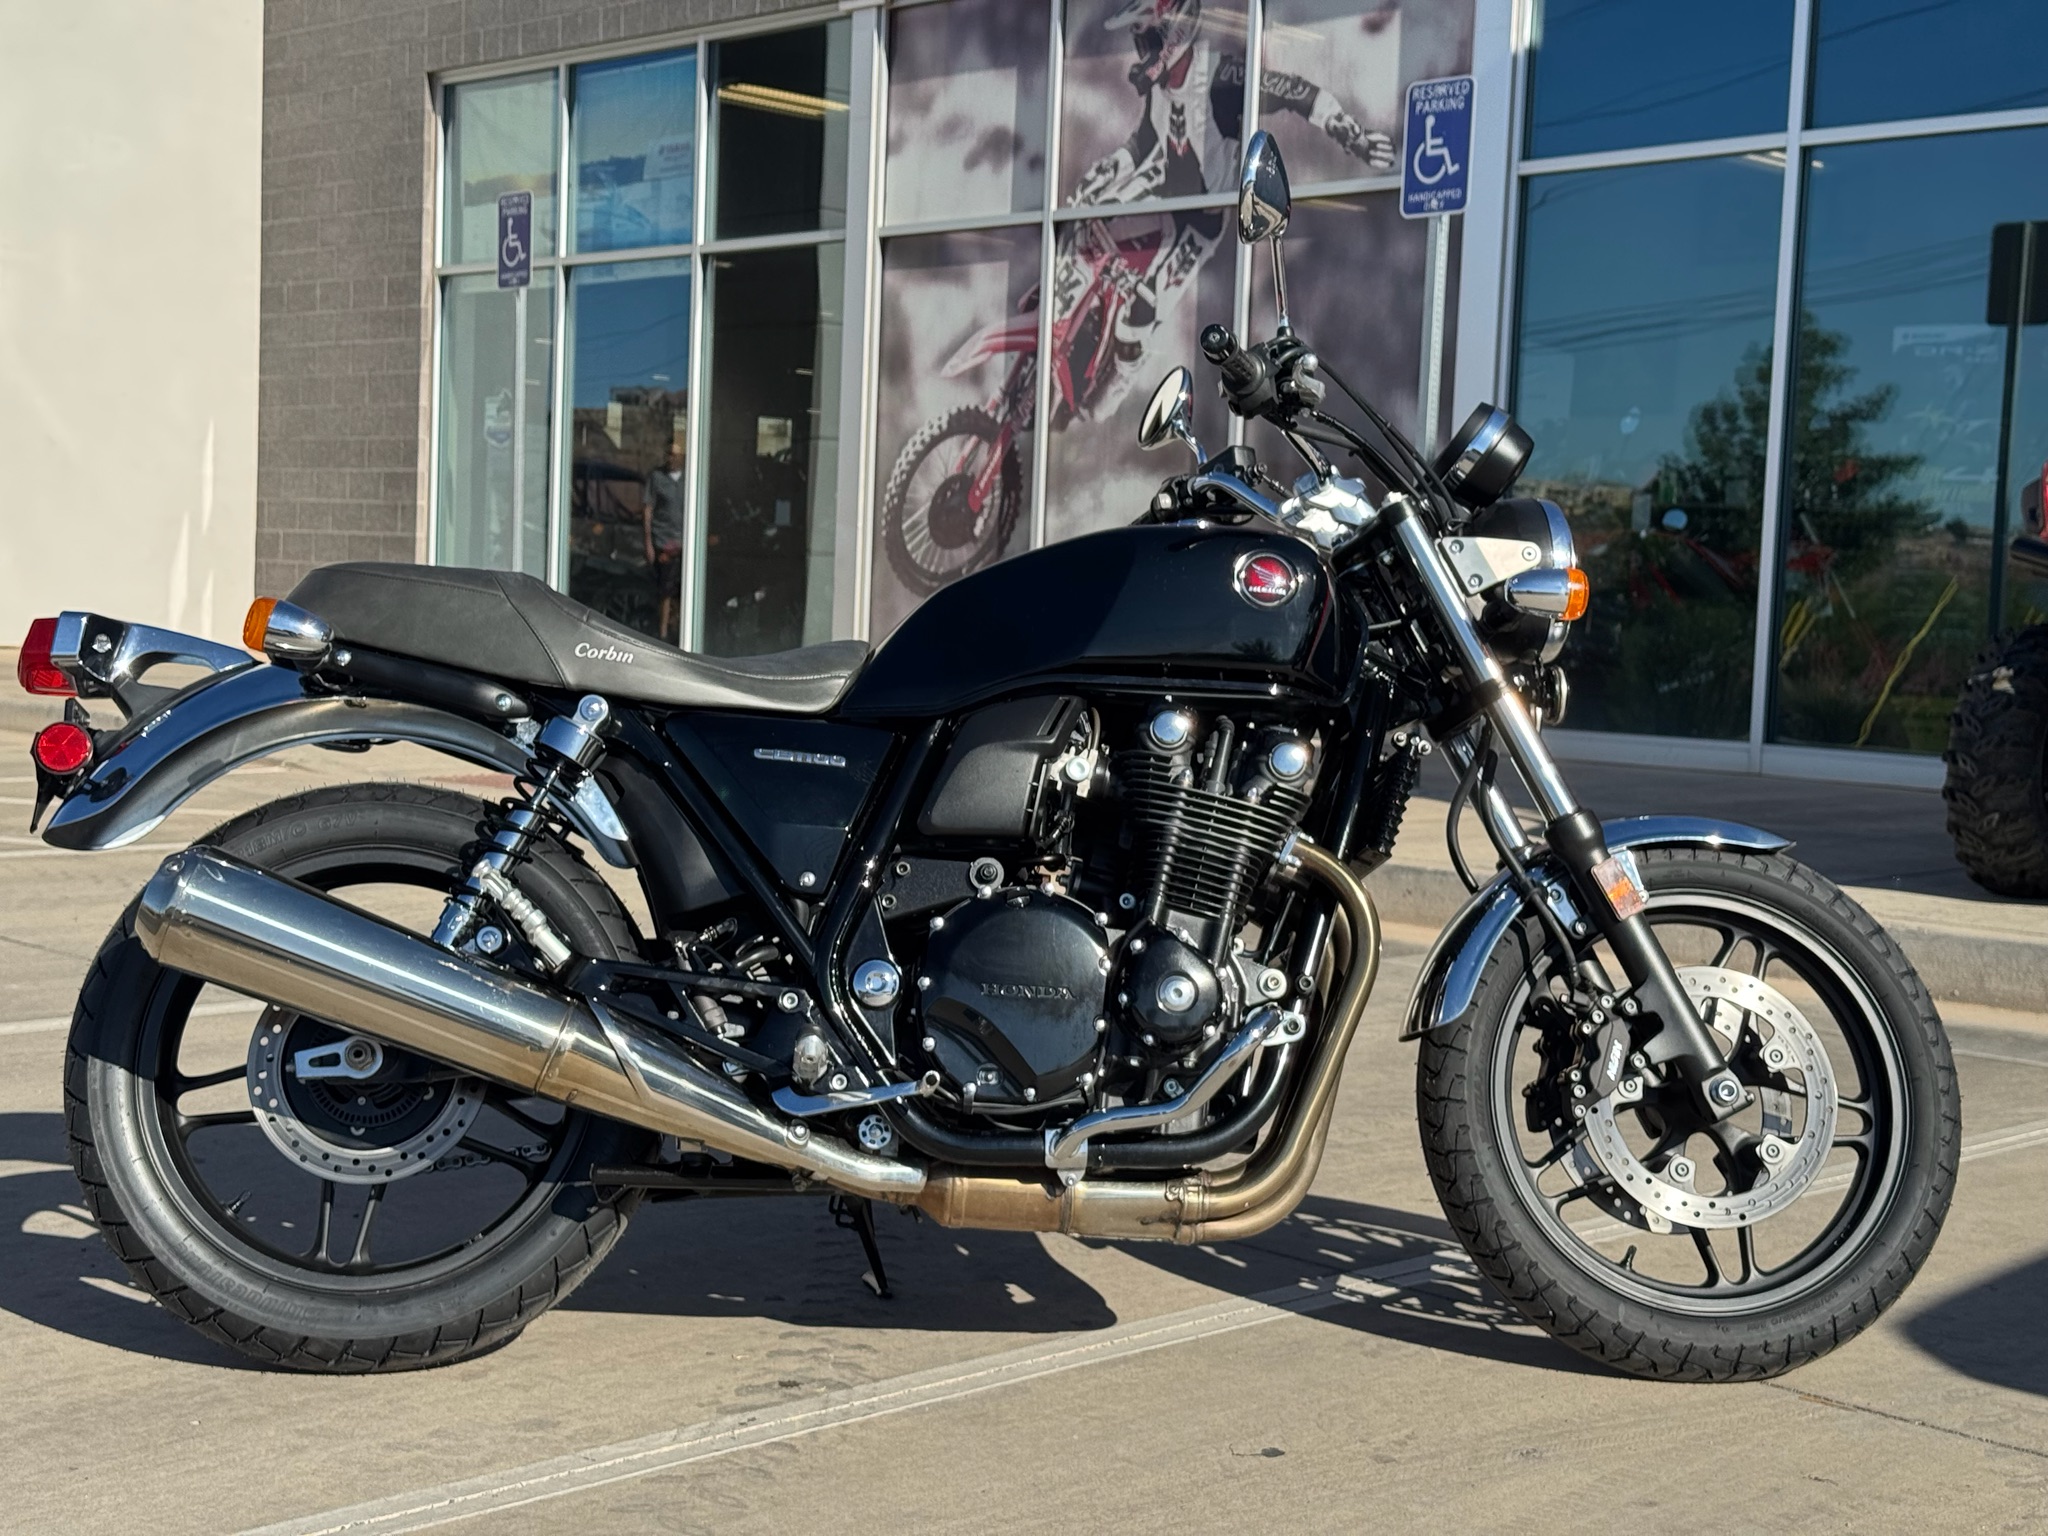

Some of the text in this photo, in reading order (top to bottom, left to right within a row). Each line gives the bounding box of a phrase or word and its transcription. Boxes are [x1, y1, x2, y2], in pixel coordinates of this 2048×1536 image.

[1415, 97, 1466, 115] PARKING
[1408, 187, 1463, 203] HANDICAPPED
[1423, 200, 1446, 212] OY
[574, 642, 634, 664] Corbin
[980, 982, 1076, 1001] HONDA
